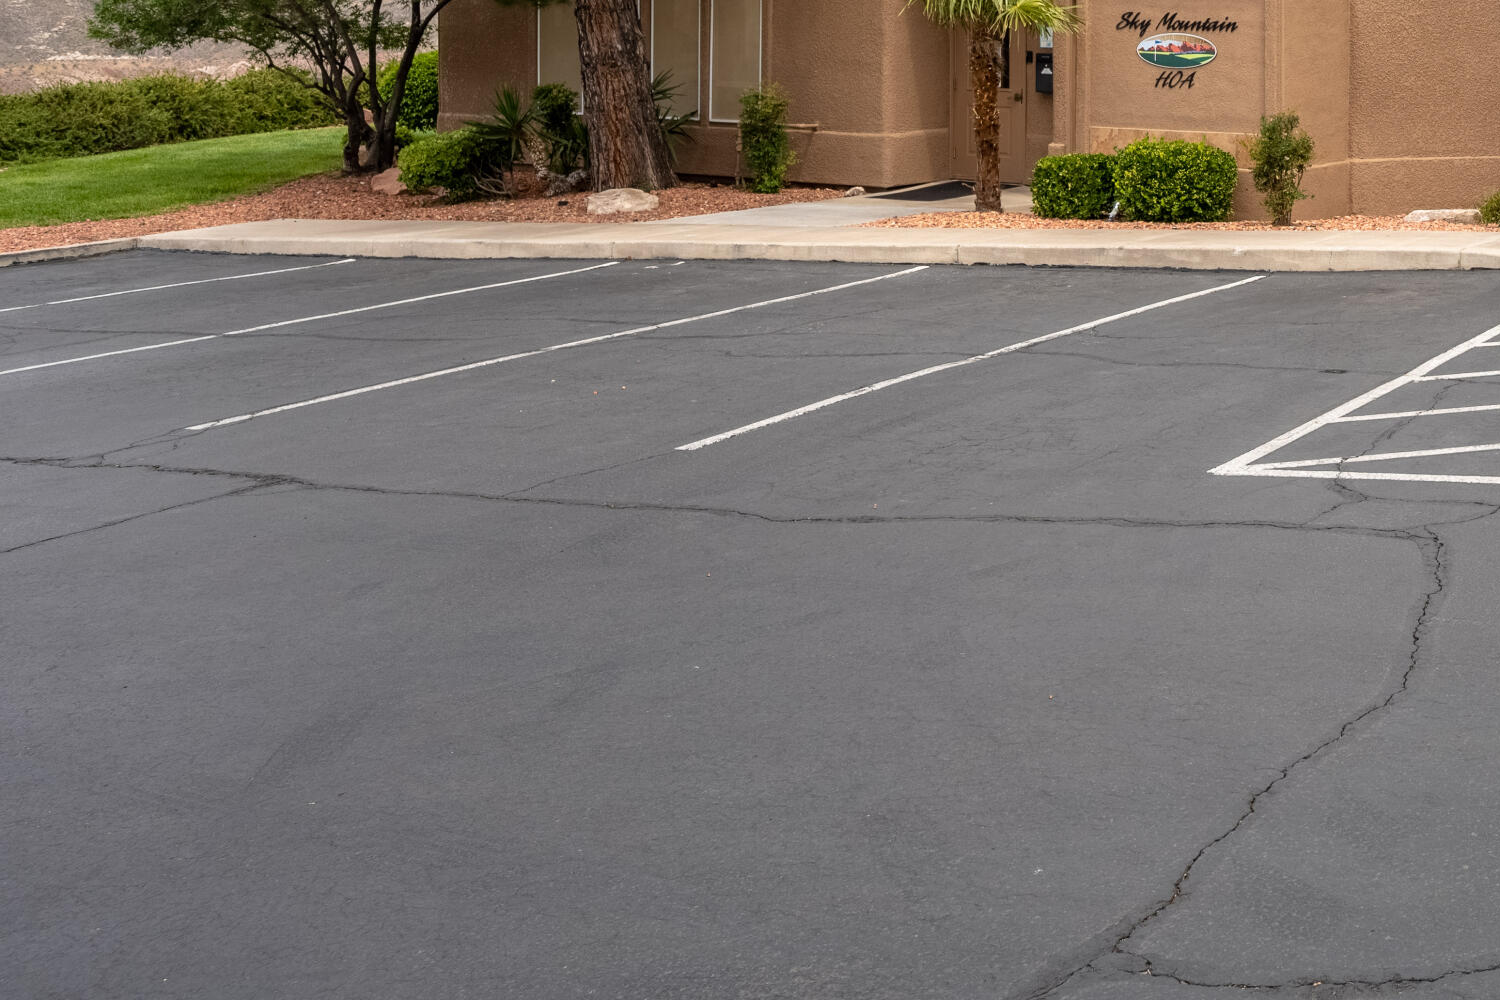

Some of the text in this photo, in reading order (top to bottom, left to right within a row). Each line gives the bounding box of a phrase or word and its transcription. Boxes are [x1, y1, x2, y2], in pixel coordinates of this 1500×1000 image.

[1116, 11, 1238, 37] Sky Mountain
[1154, 70, 1197, 89] HOA
